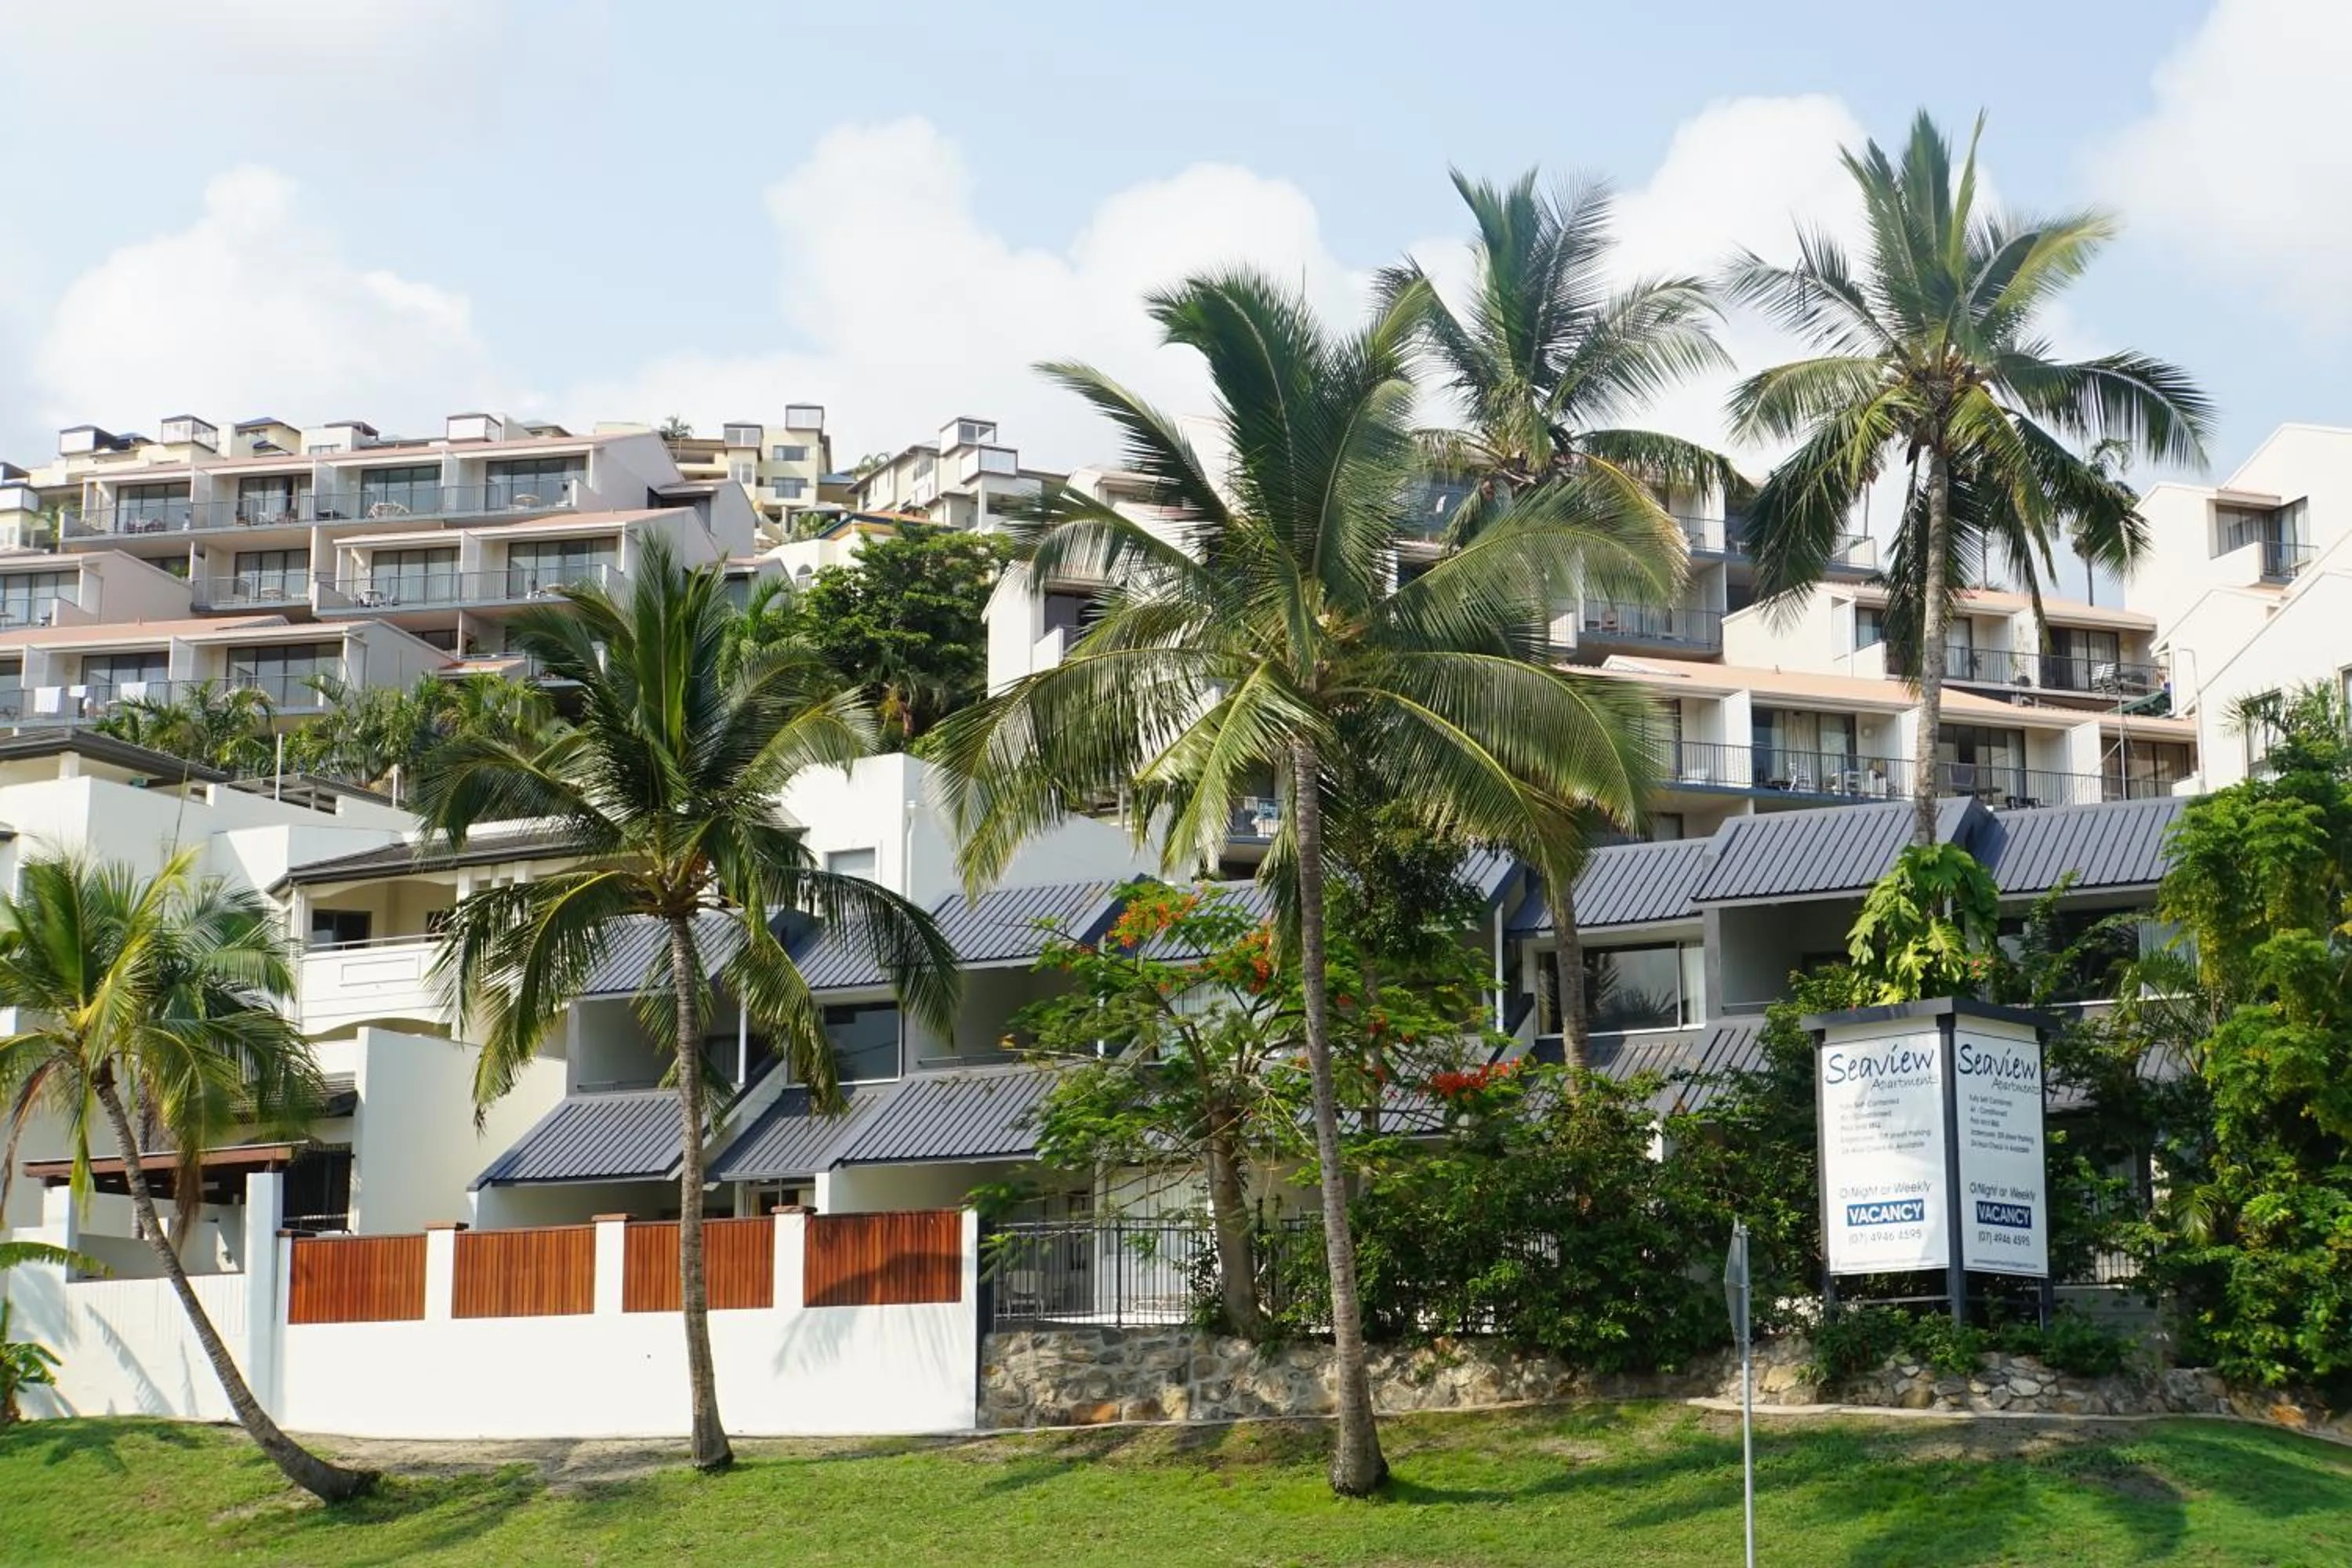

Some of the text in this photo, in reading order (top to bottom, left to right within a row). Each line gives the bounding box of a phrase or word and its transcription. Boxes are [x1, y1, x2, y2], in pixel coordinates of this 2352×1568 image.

[1826, 1044, 1934, 1084] Seaview
[1958, 1044, 2038, 1080] Seaview
[1893, 1180, 1931, 1193] Weekly
[1999, 1187, 2007, 1197] or
[2010, 1186, 2036, 1203] Weekly
[1848, 1203, 1922, 1225] VACANCY
[1978, 1203, 2030, 1225] VACANCY
[1870, 1230, 1895, 1242] 4946
